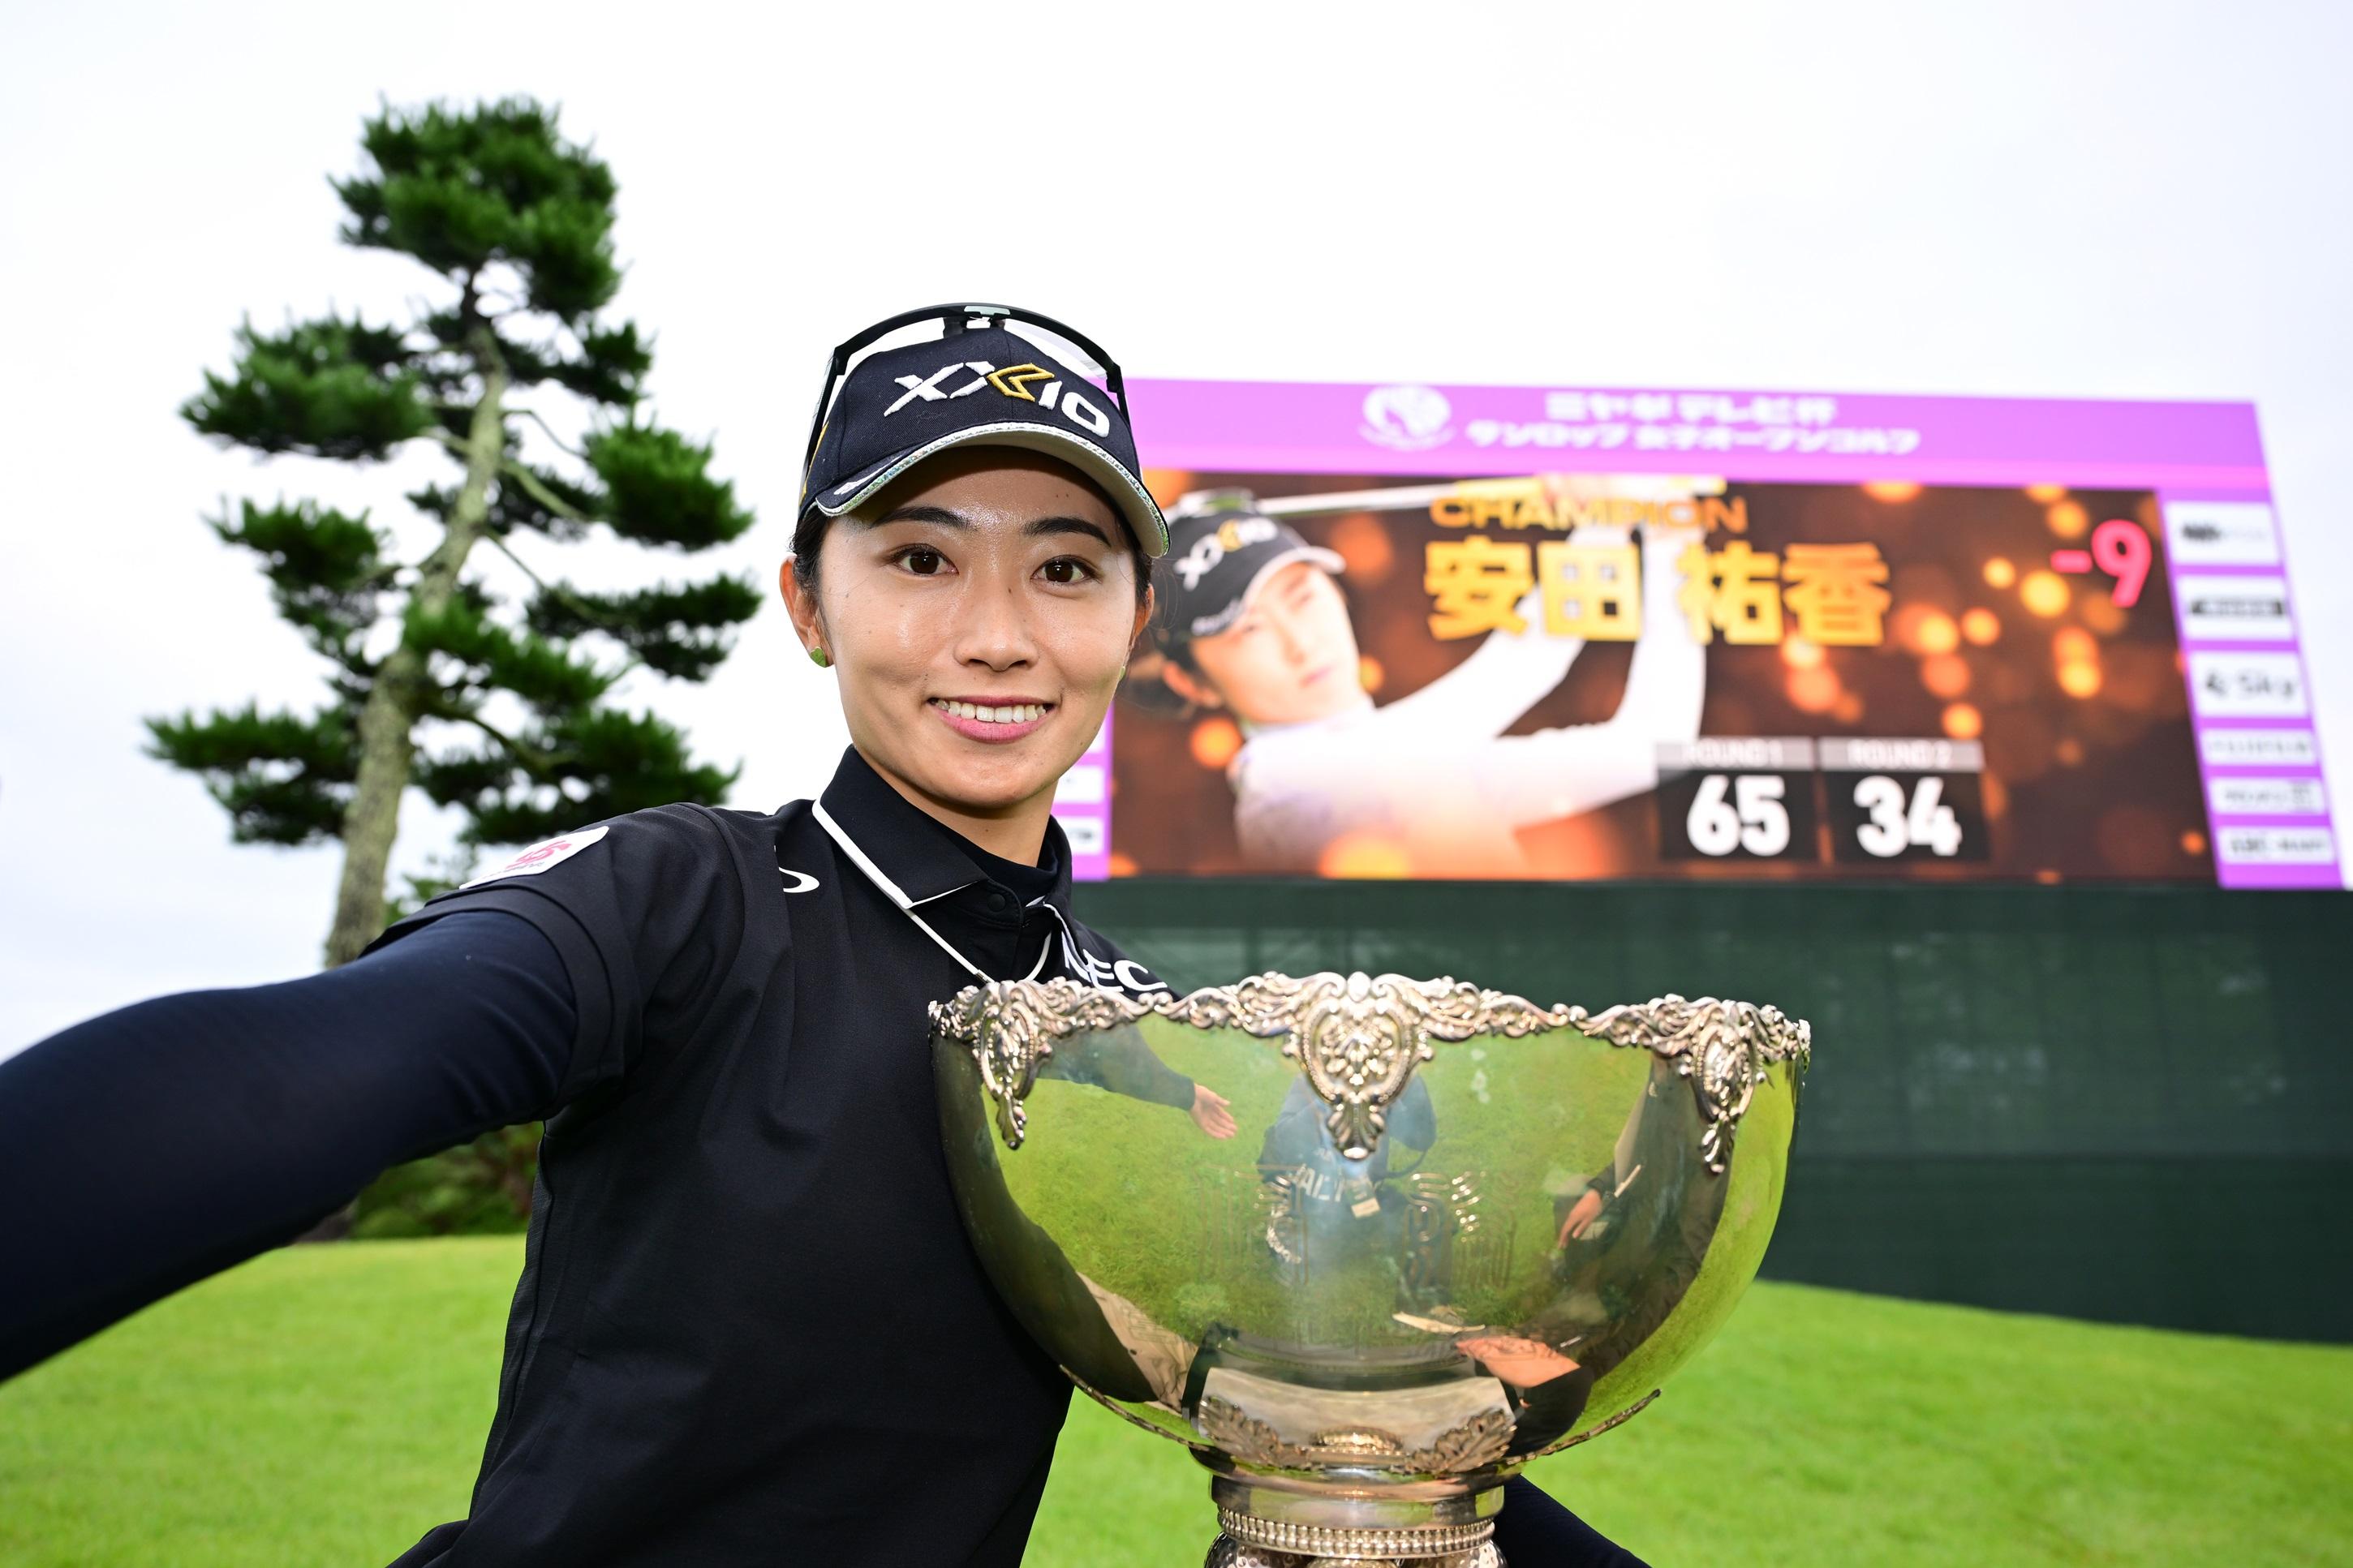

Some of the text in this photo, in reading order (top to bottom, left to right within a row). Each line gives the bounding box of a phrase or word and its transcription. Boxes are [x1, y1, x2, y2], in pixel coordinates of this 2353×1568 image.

[1430, 496, 1749, 533] CHAMPION
[1424, 535, 1892, 646] 安田 祐香
[2050, 519, 2153, 608] -9
[1687, 775, 1791, 857] 65
[1853, 775, 1962, 857] 34
